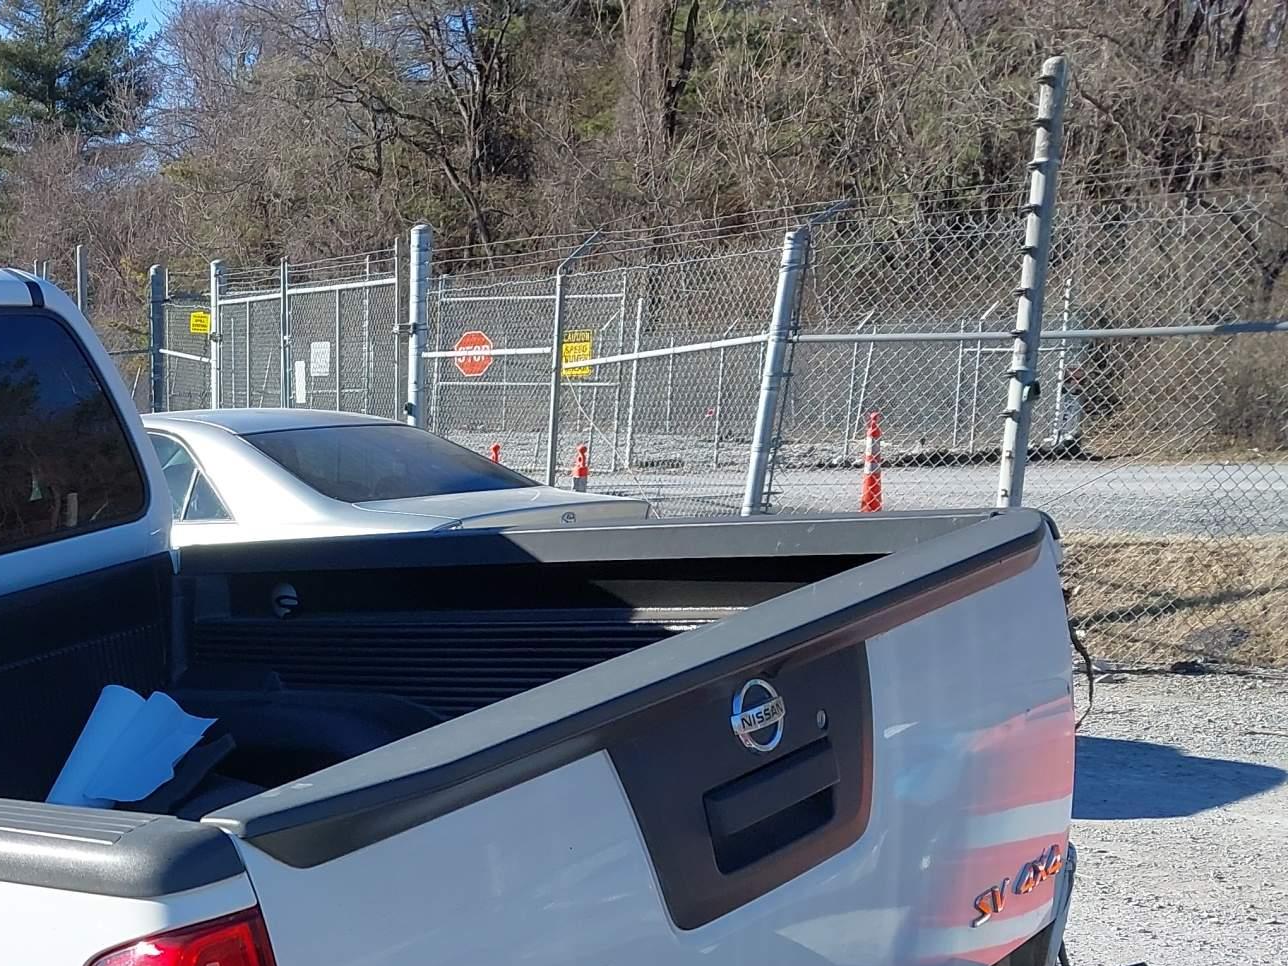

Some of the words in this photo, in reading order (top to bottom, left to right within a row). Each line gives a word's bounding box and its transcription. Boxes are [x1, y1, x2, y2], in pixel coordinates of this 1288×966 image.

[458, 345, 490, 363] STOP
[741, 703, 784, 729] NISSAN
[969, 877, 1011, 928] SV
